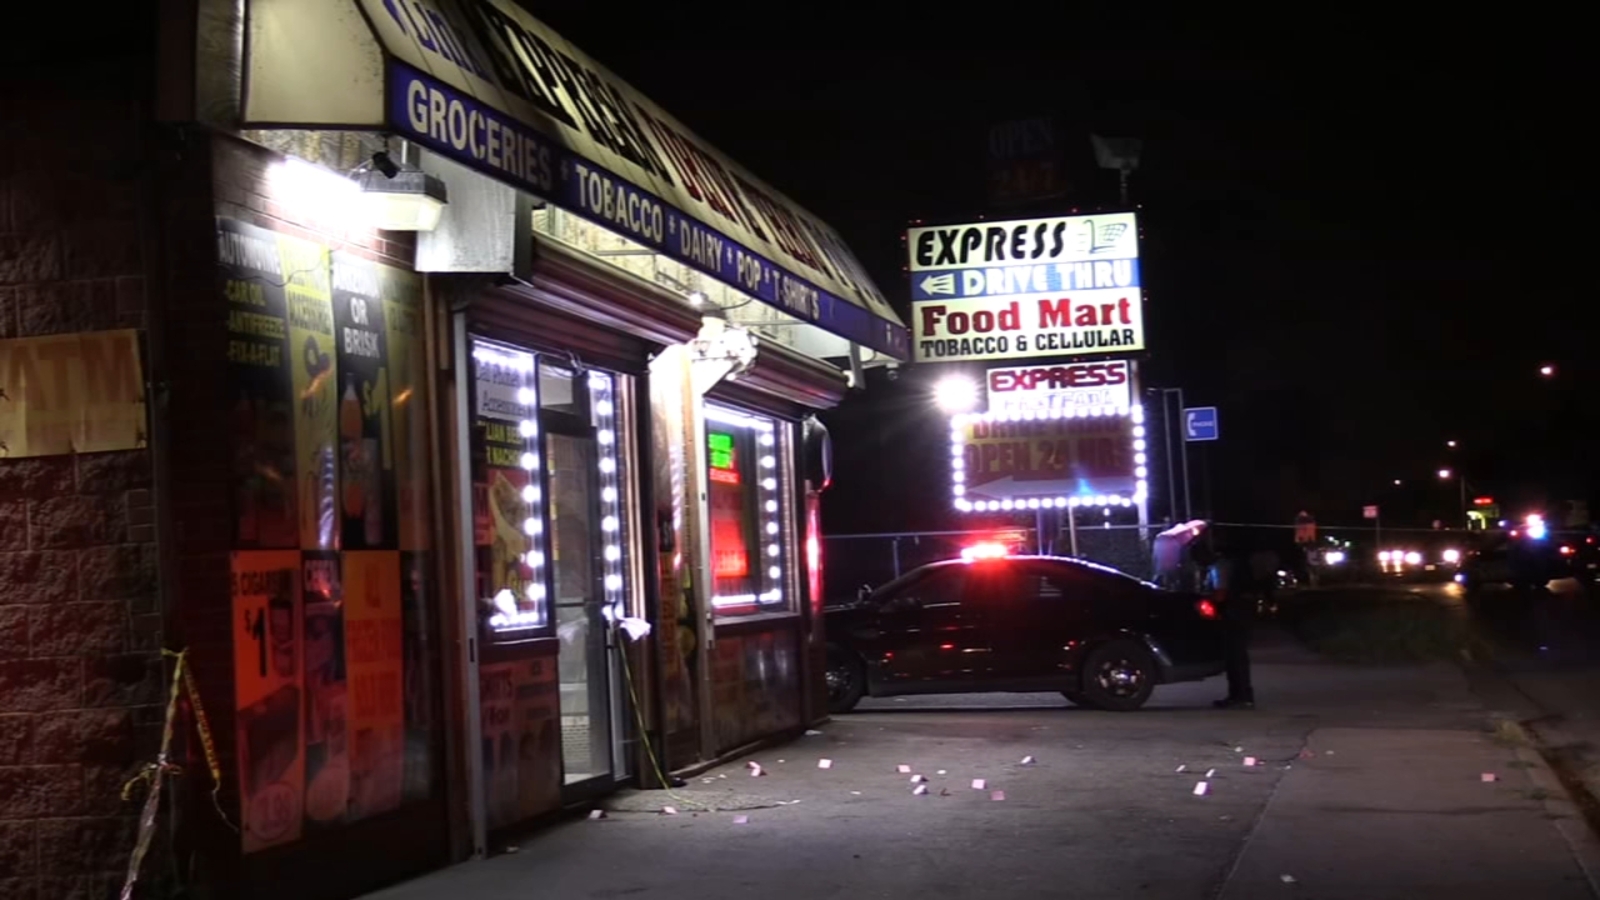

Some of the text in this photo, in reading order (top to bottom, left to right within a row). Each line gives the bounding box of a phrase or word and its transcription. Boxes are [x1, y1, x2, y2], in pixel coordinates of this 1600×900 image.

[408, 79, 549, 190] GROCERIES
[575, 163, 664, 243] TOBACCO
[680, 220, 724, 272] DAIRY
[736, 250, 762, 292] POP
[915, 221, 1067, 267] EXPRESS
[963, 260, 1133, 297] DRIVE THRU
[350, 297, 368, 326] OR
[920, 298, 1132, 337] Food Mart
[343, 327, 380, 358] BRISK
[920, 329, 1136, 358] TOBACCO & CELLULAR
[6, 335, 137, 410] ATM
[990, 363, 1126, 393] EXPRESS
[965, 440, 1031, 473] OPEN
[1037, 438, 1071, 471] 24
